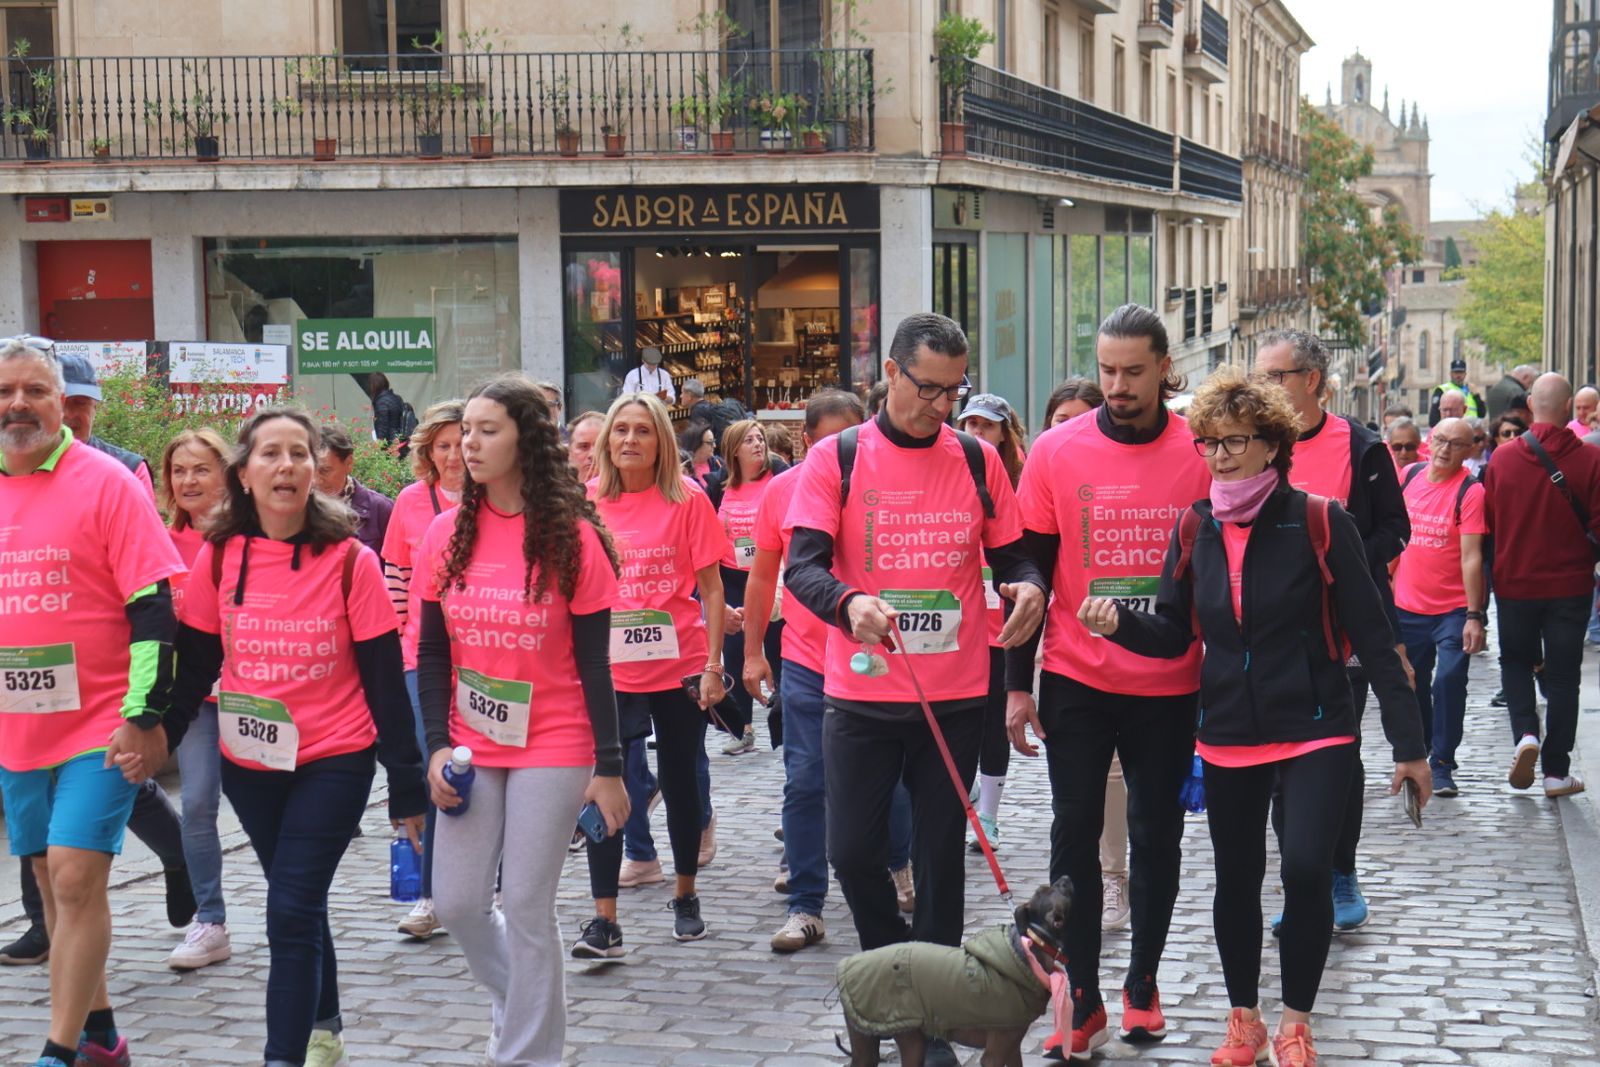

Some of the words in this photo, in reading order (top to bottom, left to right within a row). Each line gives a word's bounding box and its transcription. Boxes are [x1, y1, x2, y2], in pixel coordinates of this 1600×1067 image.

[592, 194, 696, 227] SABOR
[701, 198, 720, 222] A
[727, 191, 849, 226] ESPAÑA
[301, 331, 329, 351] SE
[336, 329, 432, 351] ALQUILA
[878, 510, 901, 525] En
[905, 508, 972, 525] marcha
[1093, 506, 1116, 520] En
[864, 511, 874, 572] SALAMANCA
[877, 529, 950, 546] contra
[953, 527, 971, 544] el
[1081, 507, 1090, 568] SALAMANCA
[1093, 524, 1164, 542] contra
[0, 544, 71, 565] marcha
[624, 545, 676, 559] marcha
[877, 547, 969, 571] cáncer
[1094, 543, 1168, 566] cánc
[0, 568, 42, 588] ntra
[46, 565, 70, 587] el
[619, 579, 678, 598] áncer
[0, 591, 73, 615] ncer
[237, 613, 259, 631] En
[264, 616, 336, 633] marcha
[448, 604, 521, 626] contra
[525, 608, 548, 628] el
[899, 612, 942, 632] 6726
[234, 637, 313, 657] contra
[316, 635, 338, 656] el
[455, 622, 546, 651] cáncer
[624, 627, 662, 644] 2625
[237, 656, 338, 681] cáncer
[5, 669, 56, 691] 5325
[469, 690, 509, 723] 5326
[238, 716, 278, 744] 5328
